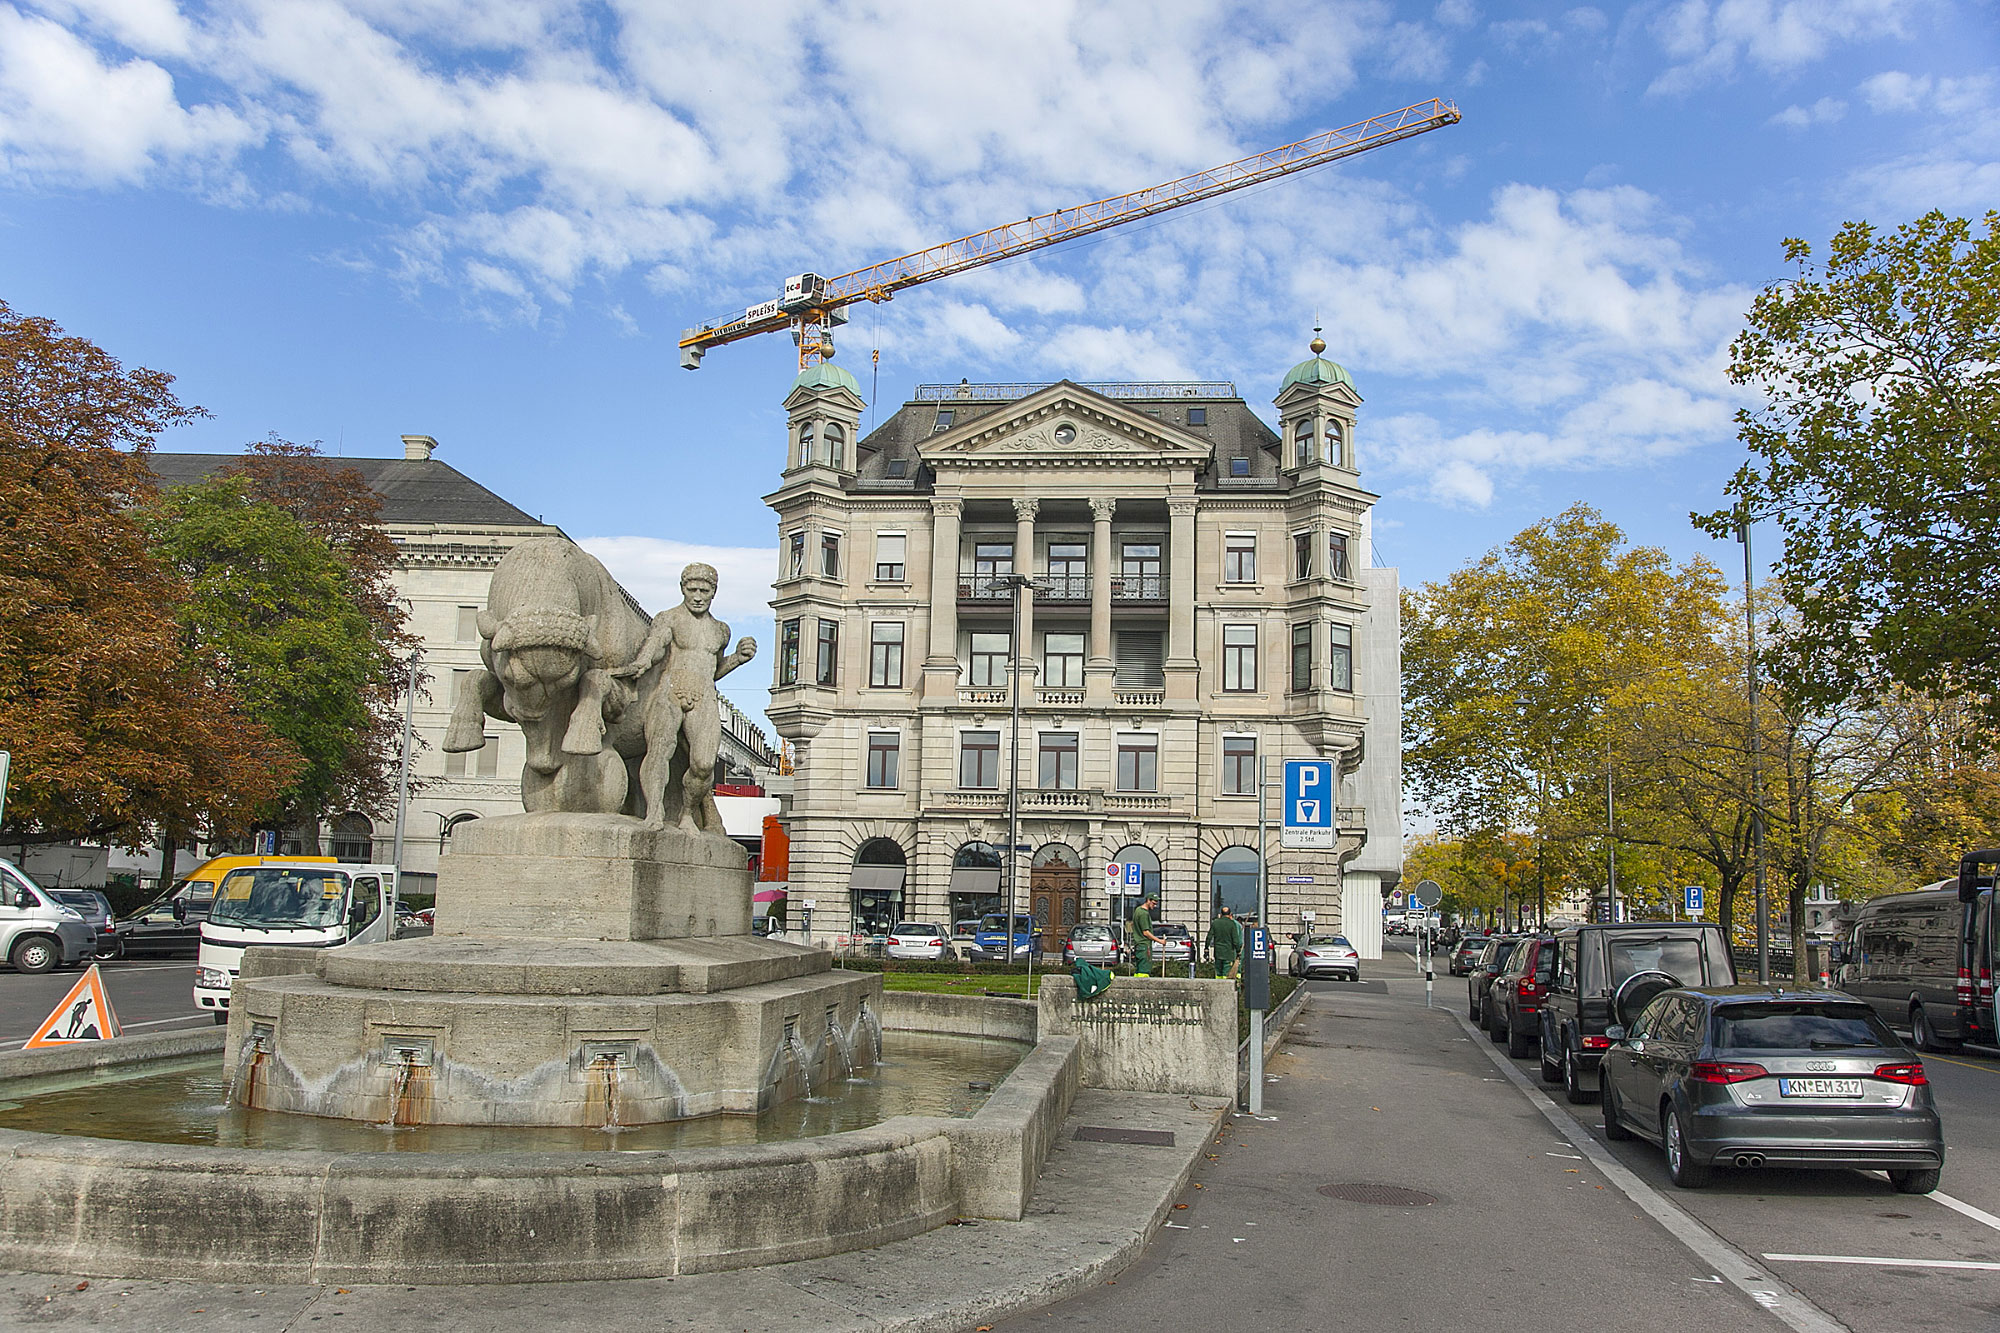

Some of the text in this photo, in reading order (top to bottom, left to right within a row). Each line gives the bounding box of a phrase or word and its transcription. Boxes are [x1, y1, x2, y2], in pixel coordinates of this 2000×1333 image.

[1299, 766, 1320, 798] P
[1130, 864, 1138, 876] P
[1690, 888, 1699, 900] P
[1254, 930, 1263, 942] P
[1789, 1080, 1860, 1094] KN EM 317
